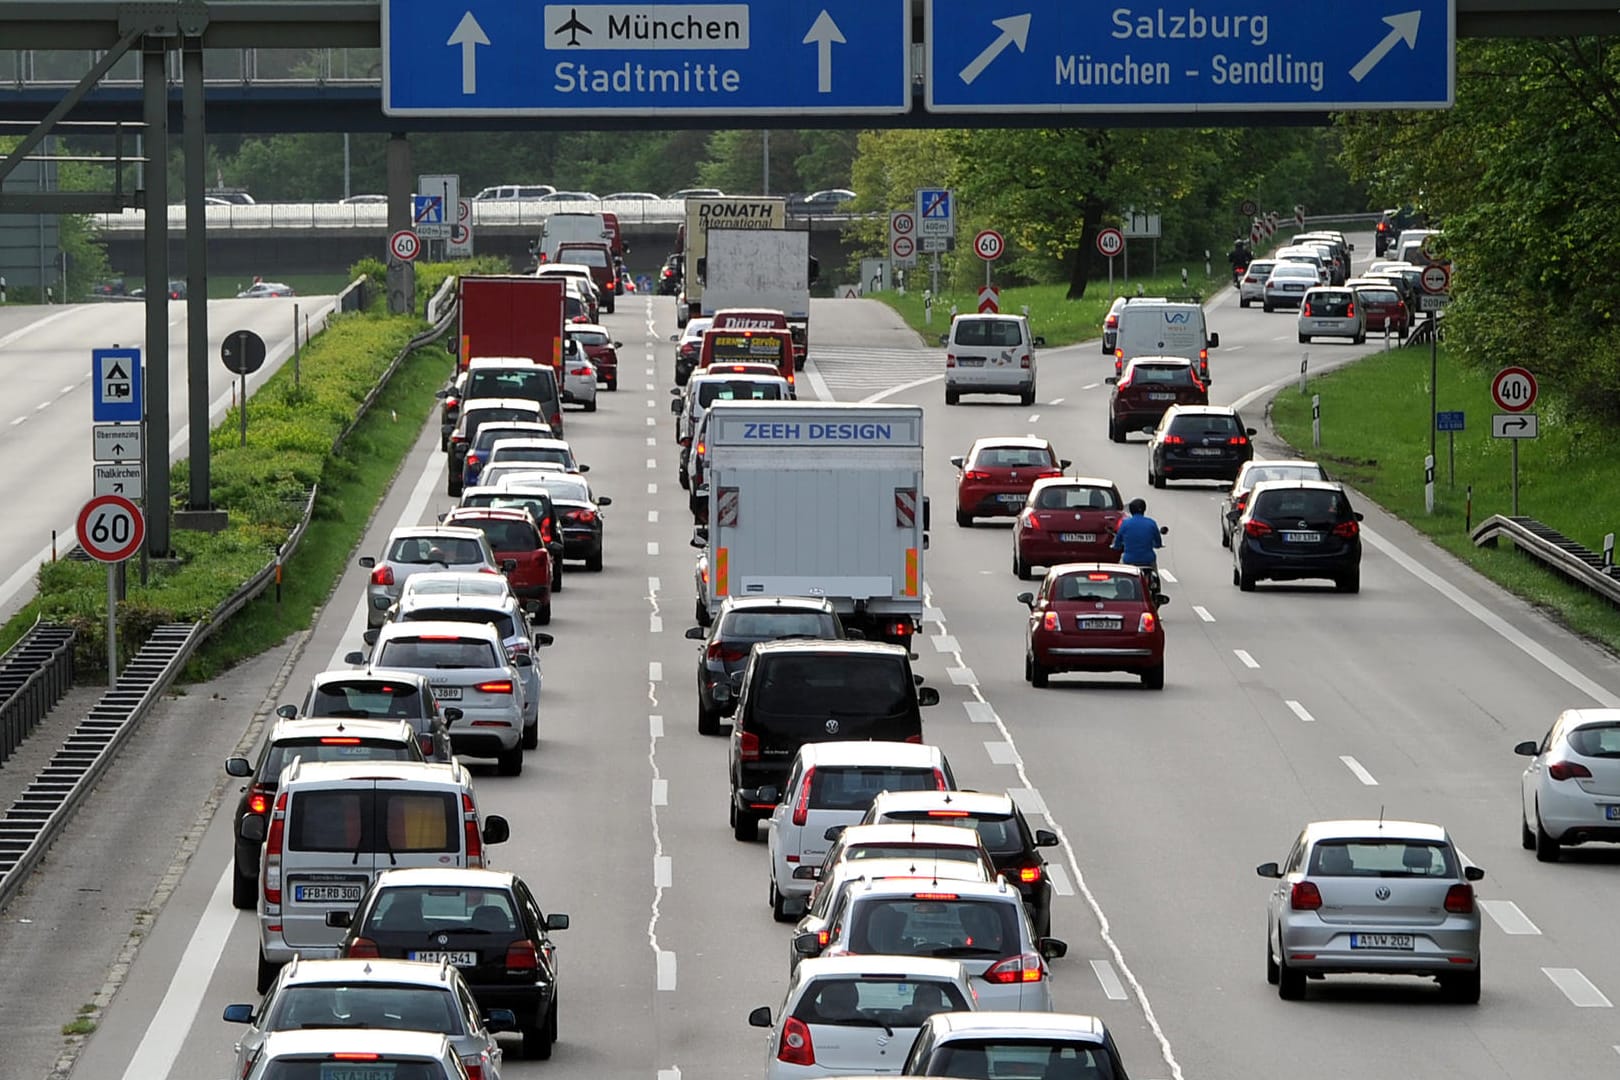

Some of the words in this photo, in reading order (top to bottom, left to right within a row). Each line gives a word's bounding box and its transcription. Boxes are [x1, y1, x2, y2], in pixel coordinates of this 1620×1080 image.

[608, 15, 740, 40] München
[1111, 8, 1269, 46] Salzburg
[554, 62, 740, 93] Stadtmitte
[1055, 55, 1170, 85] München
[1211, 53, 1324, 92] Sendling
[699, 204, 773, 218] DONATH
[898, 219, 910, 230] 60
[397, 239, 413, 252] 60
[980, 238, 997, 252] 60
[97, 430, 139, 440] Obermenzing
[744, 423, 800, 440] ZEEH
[808, 424, 891, 440] DESIGN
[97, 468, 140, 479] Thalkirchen
[92, 513, 129, 543] 60
[303, 887, 320, 898] FFB
[326, 887, 339, 898] RB
[341, 887, 359, 898] 300
[1360, 936, 1367, 946] A
[1373, 936, 1387, 946] VW
[1391, 936, 1410, 946] 202
[450, 953, 471, 964] 541
